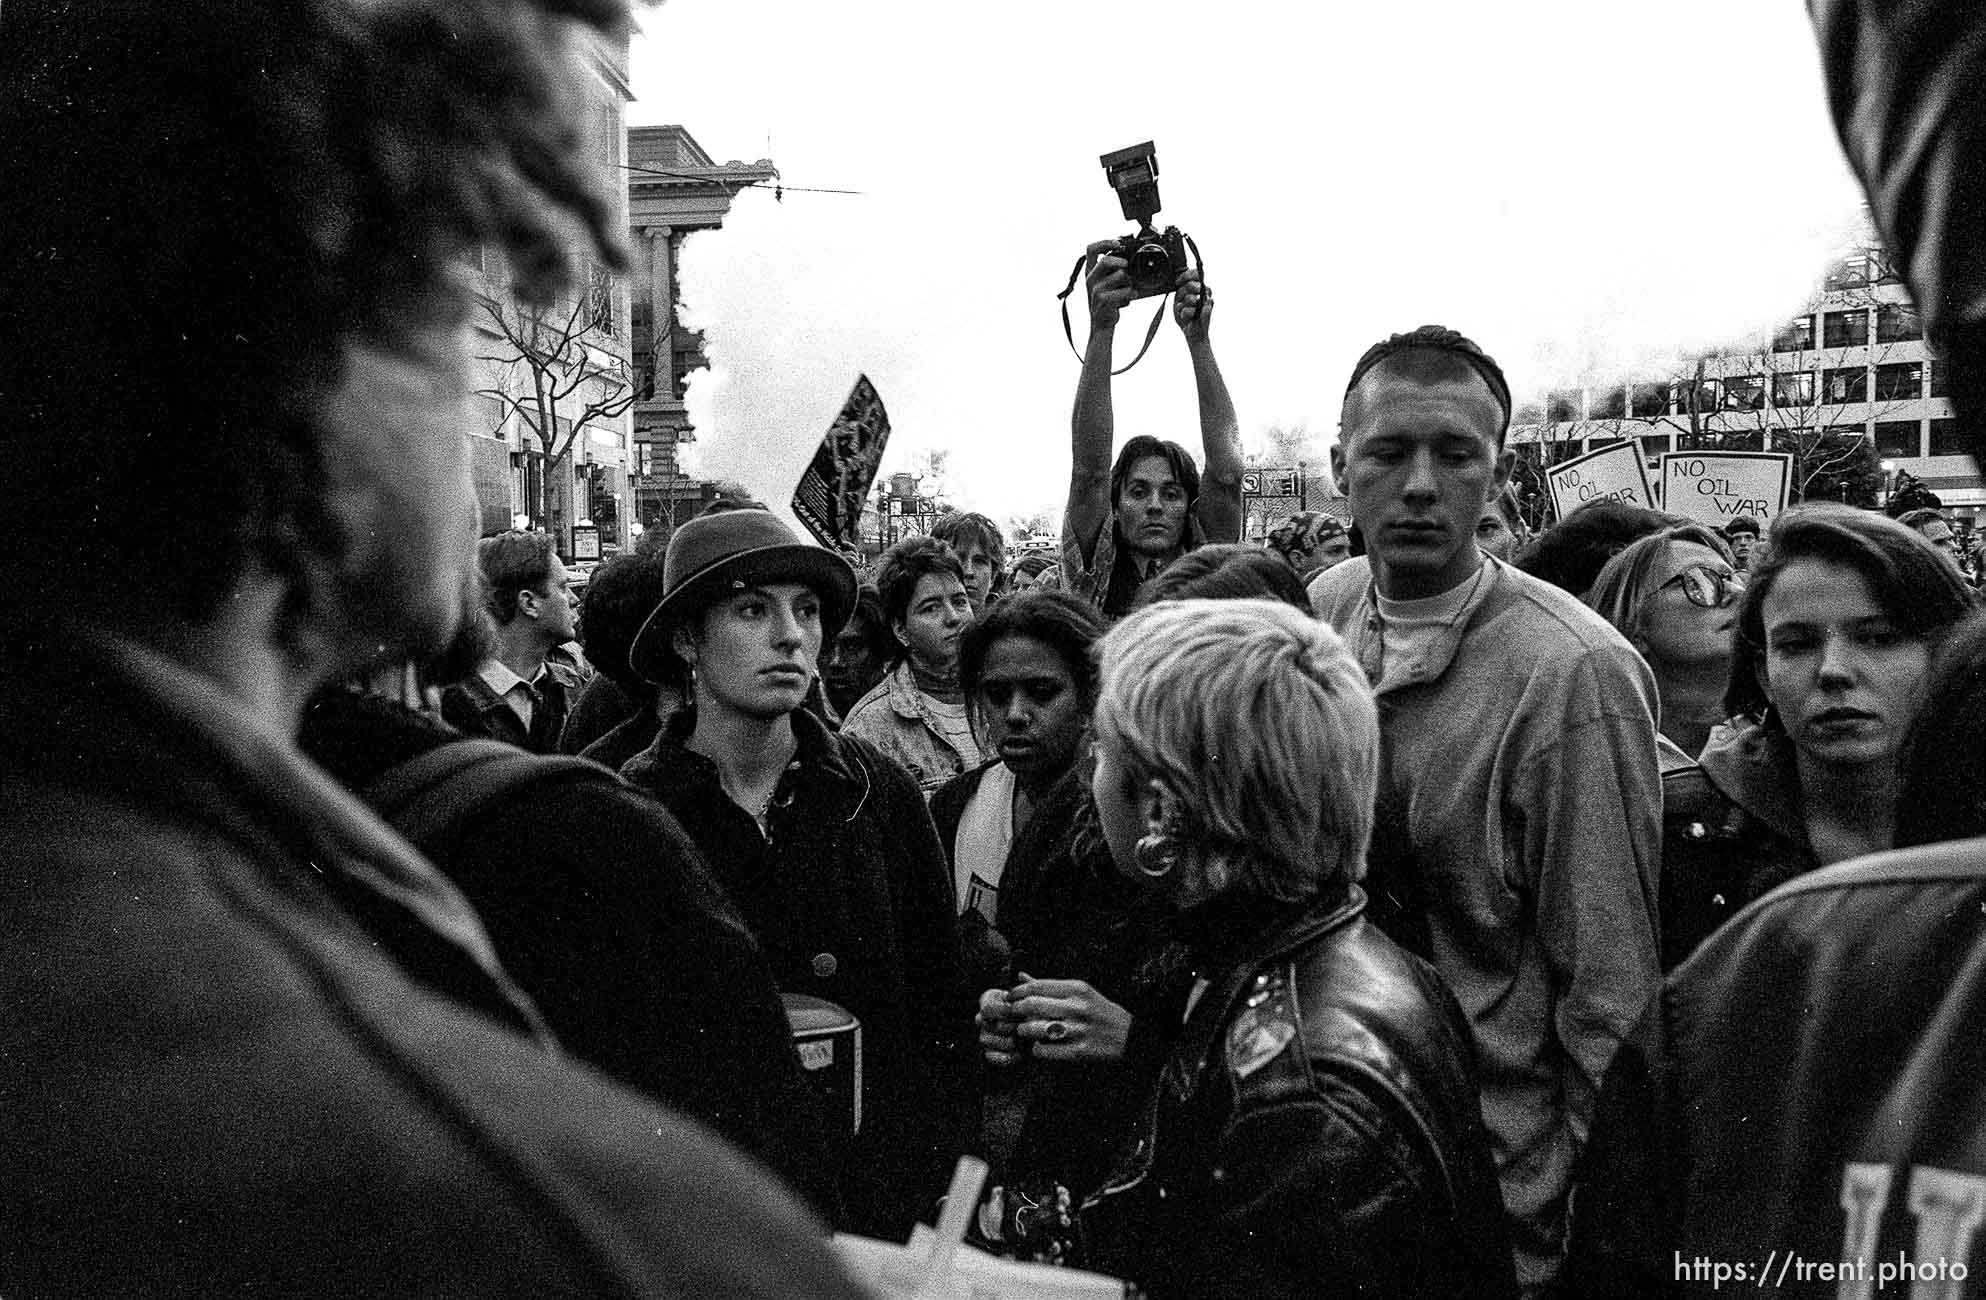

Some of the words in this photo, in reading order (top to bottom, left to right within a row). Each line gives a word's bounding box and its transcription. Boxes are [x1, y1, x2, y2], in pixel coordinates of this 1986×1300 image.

[1675, 460, 1705, 477] NO
[1559, 470, 1580, 491] NO
[1697, 479, 1739, 497] OIL
[1606, 488, 1638, 505] AR
[1713, 497, 1768, 518] WAR
